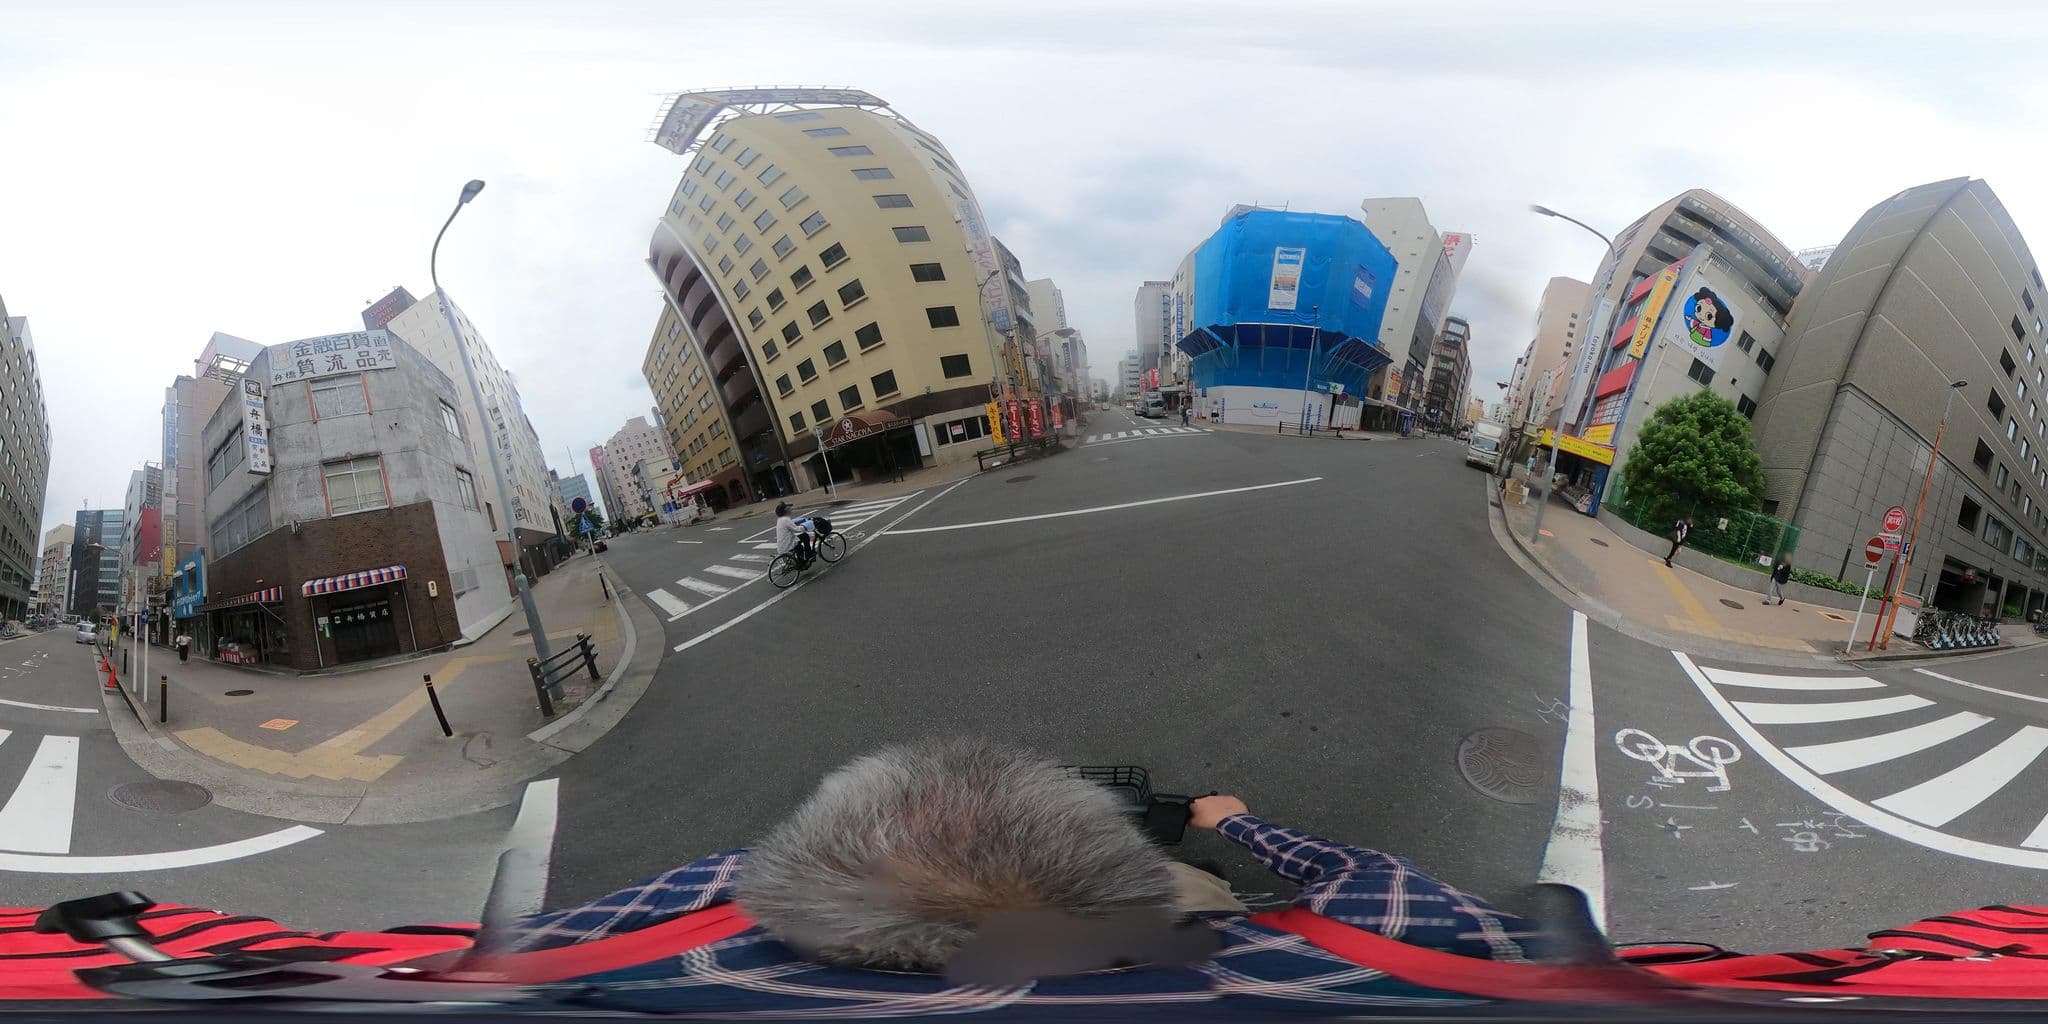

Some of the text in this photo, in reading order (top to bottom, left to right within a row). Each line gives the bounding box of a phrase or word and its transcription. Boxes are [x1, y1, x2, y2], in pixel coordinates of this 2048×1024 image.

[293, 333, 371, 358] 金融百貨
[371, 336, 393, 362] 直売
[296, 350, 378, 376] 質流品
[845, 426, 873, 440] NAGOYA
